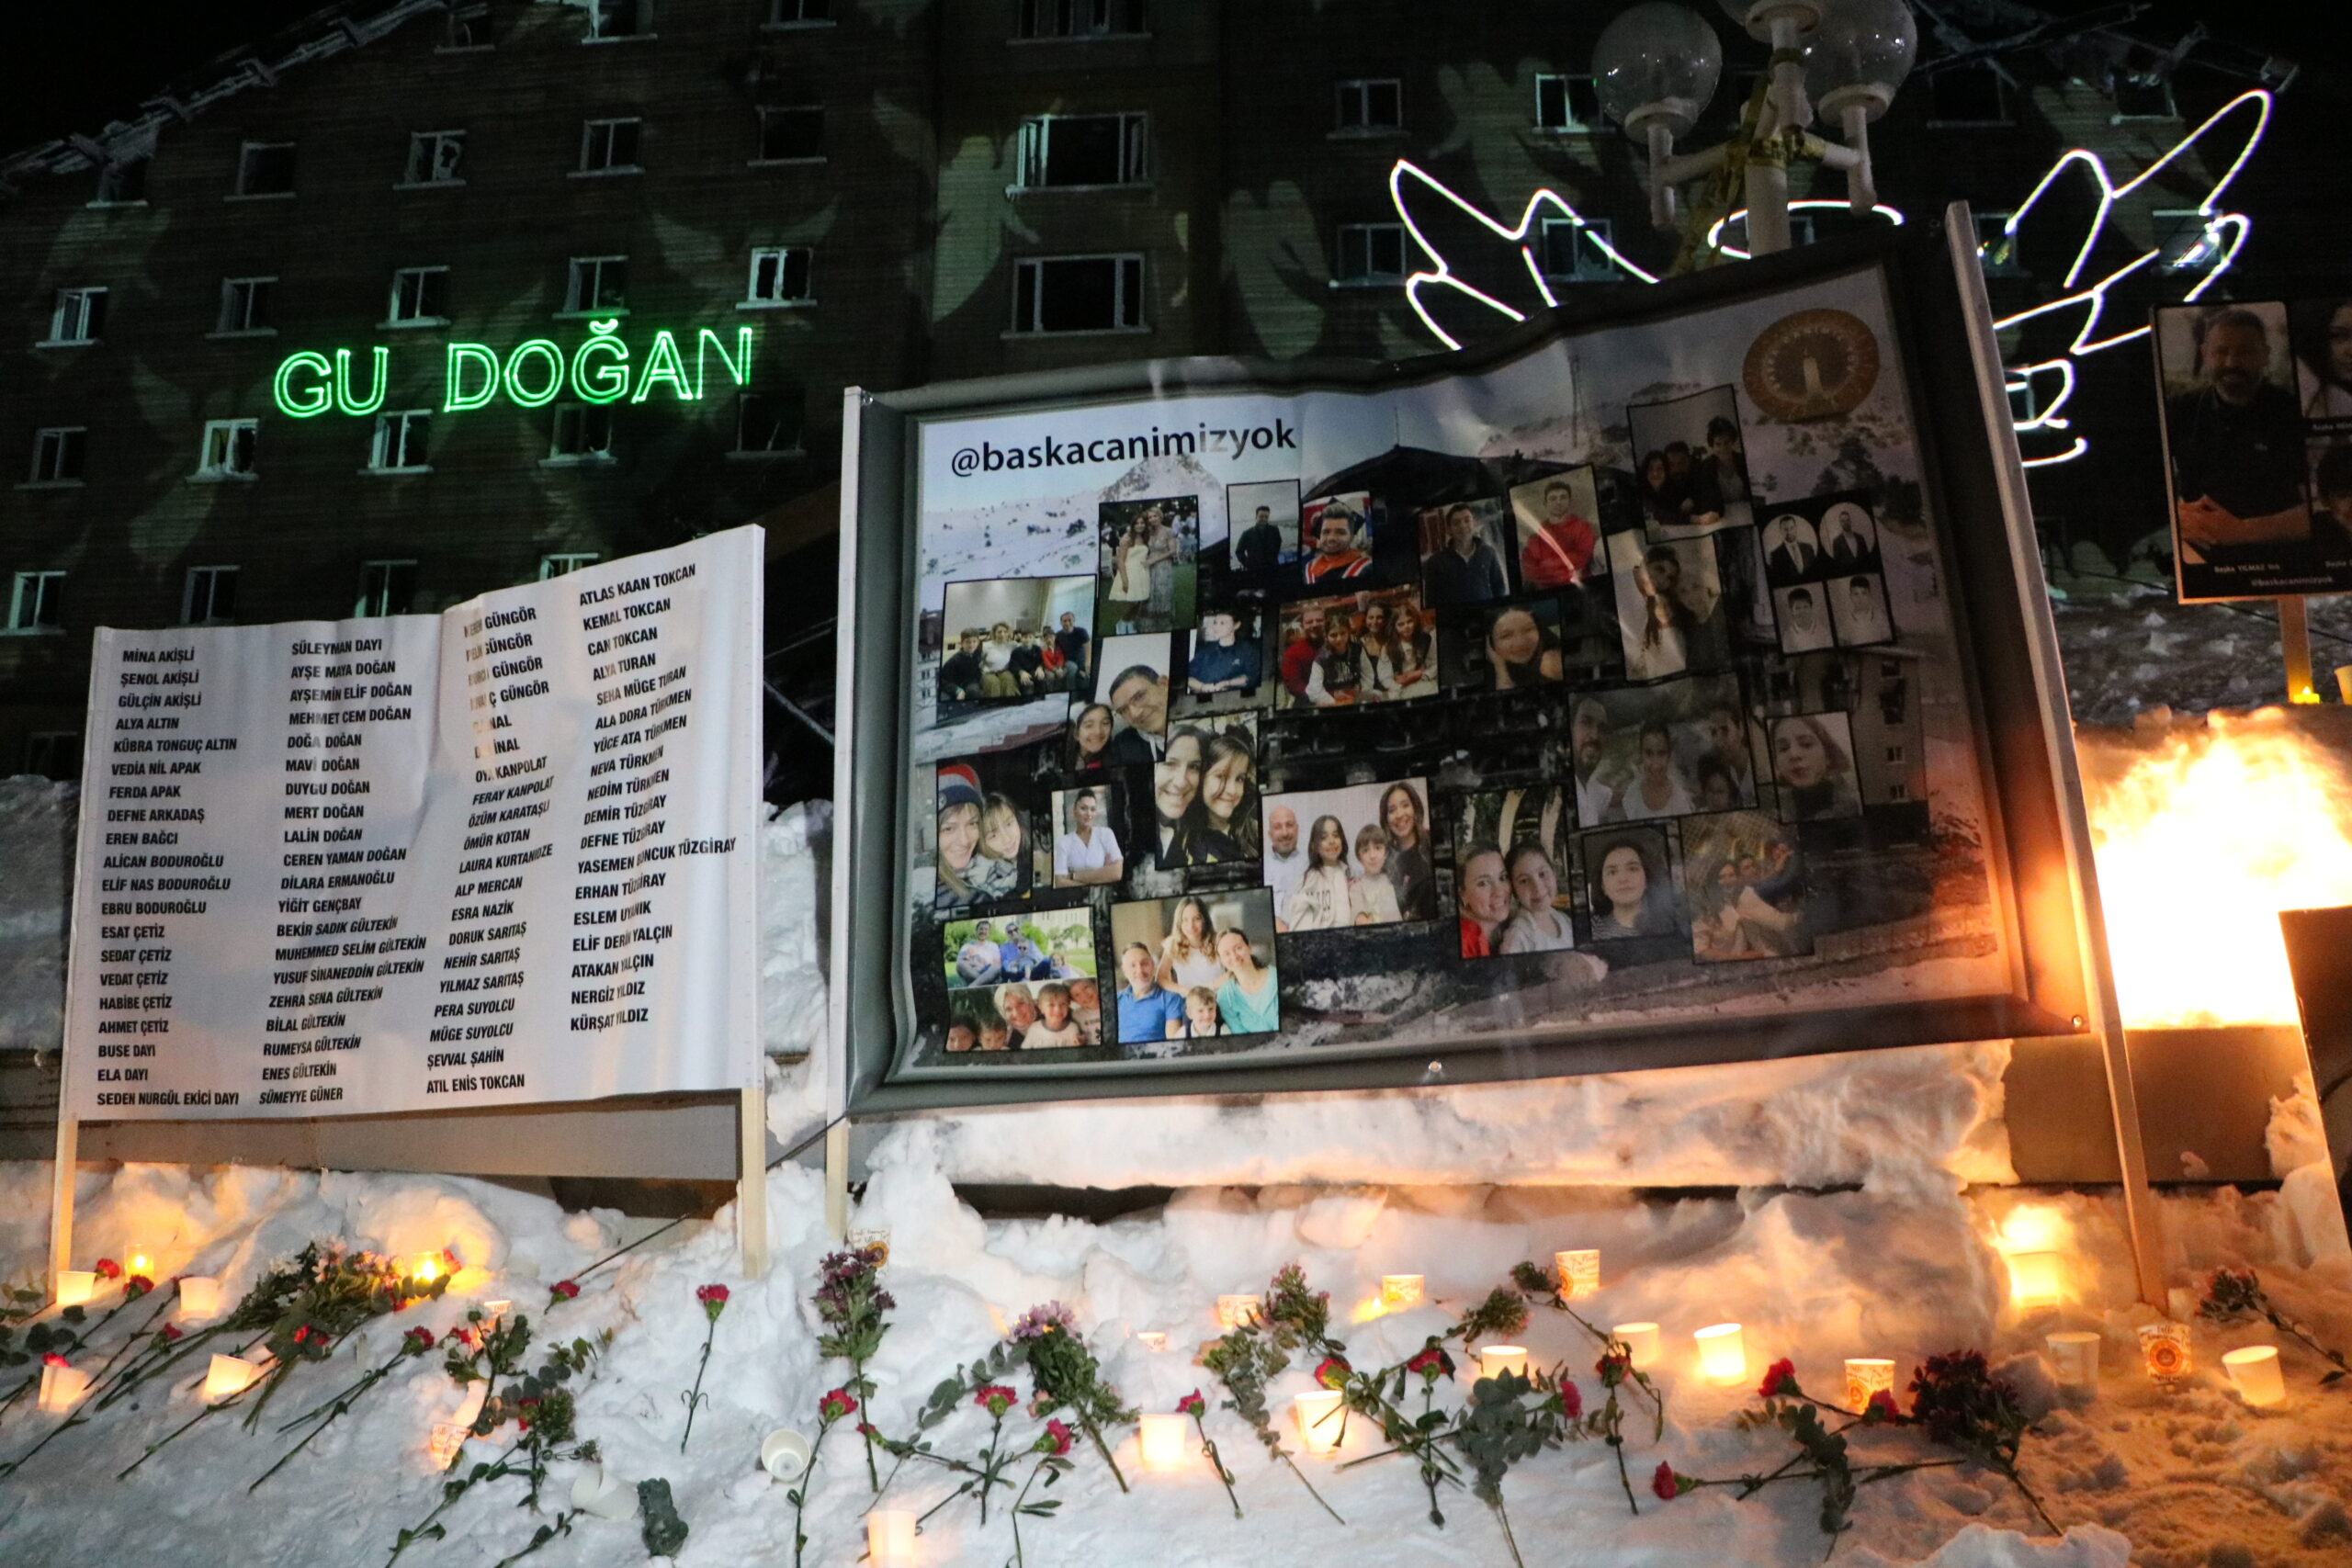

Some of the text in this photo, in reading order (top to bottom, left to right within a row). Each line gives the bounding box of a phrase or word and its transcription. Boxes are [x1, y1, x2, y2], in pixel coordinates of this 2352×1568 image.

[274, 318, 752, 418] GU DOĞAN
[952, 418, 1296, 477] @baskacanimizyok
[580, 564, 695, 606] ATLAS KAAN TOKCAN
[485, 606, 537, 629] GÜNGÖR
[583, 598, 671, 630] KEMAL TOKCAN
[292, 639, 382, 655] SÜLEYMAN DAYI
[588, 627, 657, 656] CAN TOKCAN
[123, 646, 194, 664] MİNA AKİŞLİ
[618, 653, 656, 672] TURAN
[291, 660, 395, 680] AYŞE MAYA DOĞAN
[492, 656, 543, 678] GÜNGÖR
[121, 671, 199, 688] ŞENOL AKİŞLİ
[624, 676, 656, 696] MÜGE
[290, 682, 412, 703] AYŞEMİN ELİF DOĞAN
[501, 680, 549, 702] GÜNGÖR
[119, 693, 201, 710] GÜLÇİN AKİŞLİ
[116, 717, 179, 730] ALYA ALTIN
[342, 707, 411, 724] CEM DOĞAN
[595, 707, 647, 729] ALA DORA
[113, 738, 237, 755] KÜBRA TONGUÇ ALTIN
[325, 733, 361, 748] DOĞAN
[594, 729, 641, 753] YÜCE ATA
[112, 761, 200, 775] VEDİA NİL APAK
[322, 757, 359, 771] DOĞAN
[494, 756, 547, 779] KANPOLAT
[591, 759, 616, 777] NEVA
[109, 785, 181, 798] FERDA APAK
[331, 780, 369, 795] DOĞAN
[587, 782, 622, 801] NEDİM
[472, 789, 504, 806] FERAY
[107, 808, 204, 824] DEFNE ARKADAŞ
[285, 804, 364, 818] MERT DOĞAN
[469, 810, 496, 828] ÖZÜM
[584, 804, 620, 825] DEMİR
[106, 830, 177, 845] EREN BAĞCI
[284, 828, 362, 843] LALİN DOĞAN
[464, 829, 530, 851] ÖMÜR KOTAN
[581, 833, 618, 850] DEFNE
[104, 852, 223, 868] ALİCAN BODUROĞLU
[284, 846, 406, 866] CEREN YAMAN DOĞAN
[578, 836, 736, 874] YASEMEN TÜZGİRAY
[459, 857, 492, 874] LAURA
[102, 876, 231, 891] ELİF NAS BODUROĞLU
[281, 871, 394, 889] DİLARA ERMANOĞLU
[455, 876, 523, 897] ALP MERCAN
[575, 884, 618, 899] ERHAN
[102, 900, 206, 915] EBRU BODUROĞLU
[278, 897, 362, 913] YİĞİT GENÇBAY
[452, 900, 514, 920] ESRA NAZİK
[277, 914, 398, 936] BEKİR SADIK GÜLTEKİN
[574, 911, 616, 926] ESLEM
[102, 923, 164, 942] ESAT ÇETİZ
[449, 922, 526, 945] DORUK SARITAŞ
[572, 925, 673, 952] ELİF YALÇIN
[101, 946, 171, 964] SEDAT ÇETİZ
[276, 935, 426, 961] MUHEMMED SELİM GÜLTEKİN
[444, 948, 520, 969] NEHİR SARITAŞ
[274, 959, 424, 984] YUSUF SİNANEDDİN GÜLTEKİN
[571, 962, 618, 977] ATAKAN
[100, 970, 167, 988] VEDAT ÇETİZ
[439, 972, 524, 993] YILMAZ SARITAŞ
[99, 994, 172, 1012] HABİBE ÇETİZ
[269, 986, 383, 1009] ZEHRA SENA GÜLTEKİN
[571, 987, 614, 1004] NERGİZ
[435, 998, 514, 1017] PERA SUYOLCU
[98, 1018, 169, 1036] AHMET ÇETİZ
[266, 1017, 298, 1032] BİLAL
[571, 1010, 614, 1033] KÜRŞAT
[430, 1022, 514, 1042] MÜGE SUYOLCU
[98, 1044, 155, 1057] BUSE DAYI
[264, 1035, 360, 1055] RUMEYSA GÜLTEKİN
[427, 1048, 504, 1067] ŞEVVAL ŞAHİN
[98, 1069, 148, 1081] ELA DAYI
[263, 1062, 336, 1080] ENES GÜLTEKİN
[427, 1074, 525, 1094] ATIL ENİS TOKCAN
[97, 1089, 239, 1105] SEDEN NURGÜL EKİCİ DAYI
[260, 1087, 343, 1103] SÜMEYYE GÜNER
